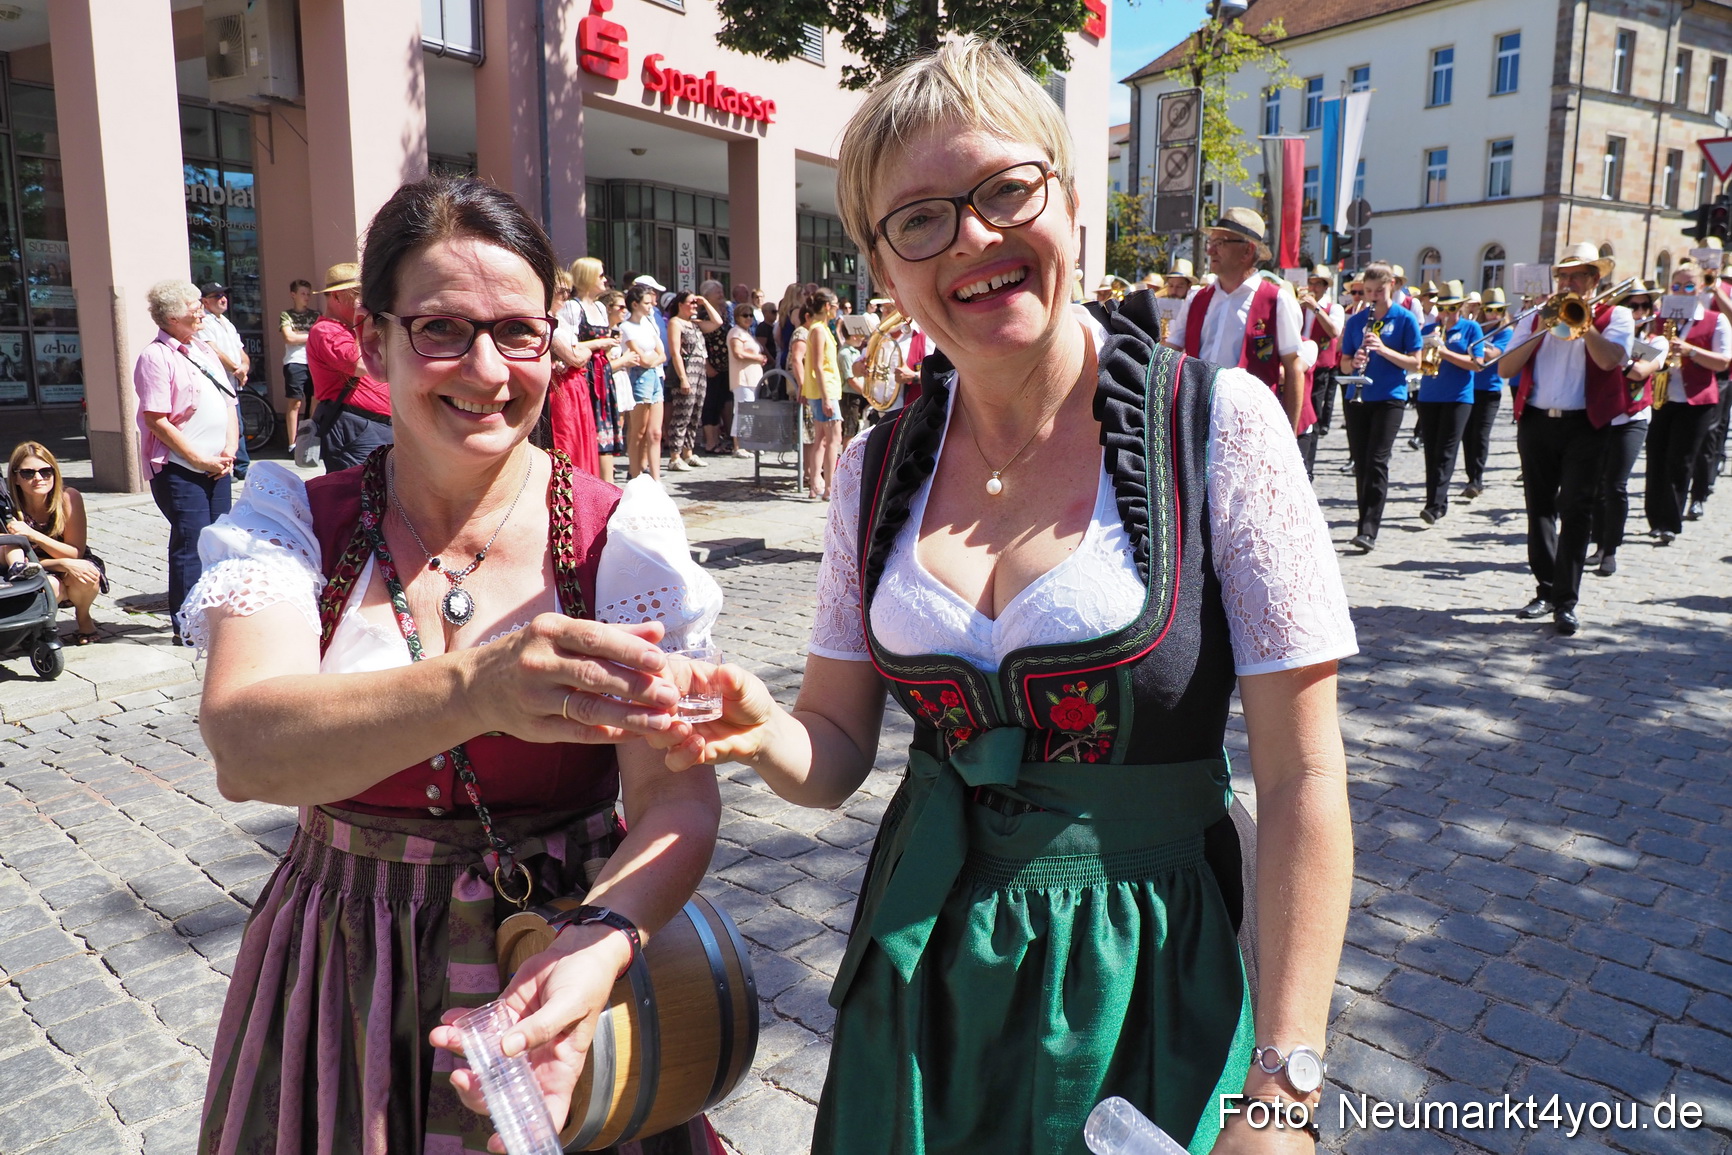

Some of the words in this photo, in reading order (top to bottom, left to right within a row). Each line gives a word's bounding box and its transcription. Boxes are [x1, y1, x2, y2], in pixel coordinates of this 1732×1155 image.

[642, 53, 777, 124] Sparkasse
[1172, 107, 1187, 121] 30
[29, 241, 62, 254] SÜDEN
[43, 339, 77, 354] a-ha
